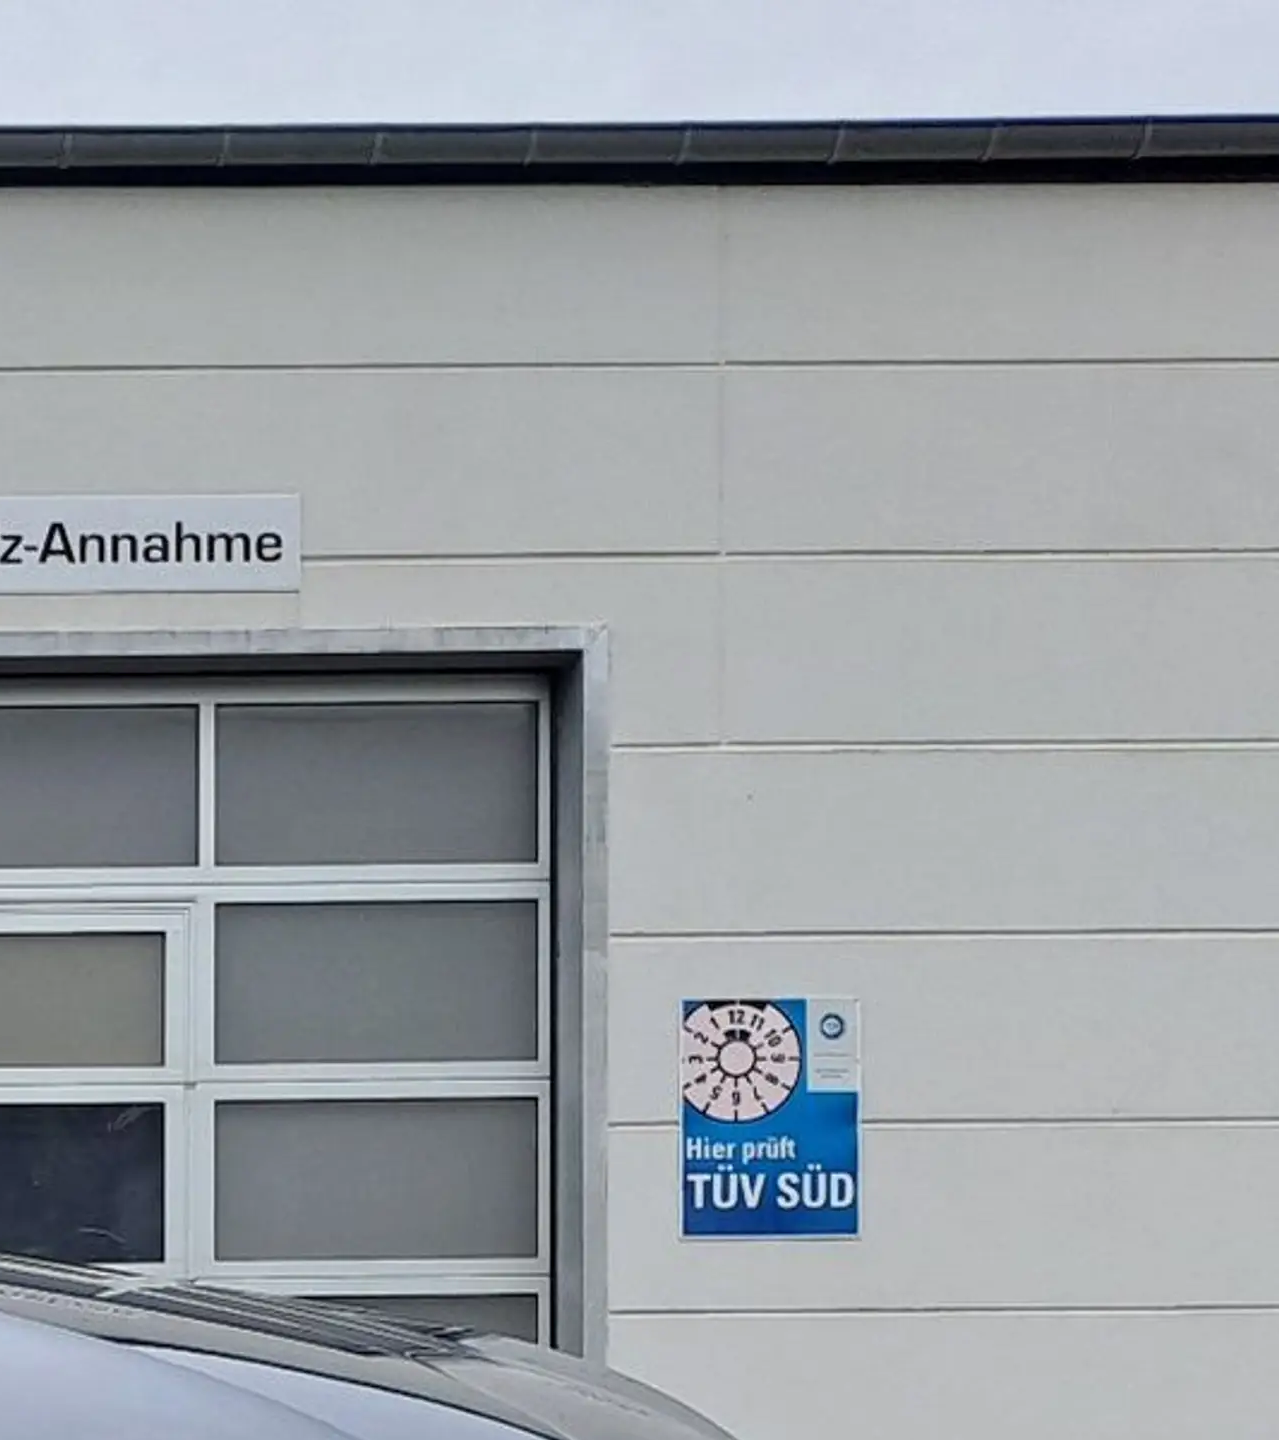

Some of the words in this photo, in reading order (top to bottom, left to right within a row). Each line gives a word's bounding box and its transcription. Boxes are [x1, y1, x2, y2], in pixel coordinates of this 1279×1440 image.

[710, 1017, 720, 1030] 1
[728, 1009, 745, 1024] 12
[750, 1014, 764, 1031] 11
[763, 1028, 783, 1047] 10
[686, 1137, 736, 1161] Hier
[742, 1136, 796, 1164] prüft
[686, 1164, 766, 1209] TÜV
[776, 1163, 855, 1209] SÜD
